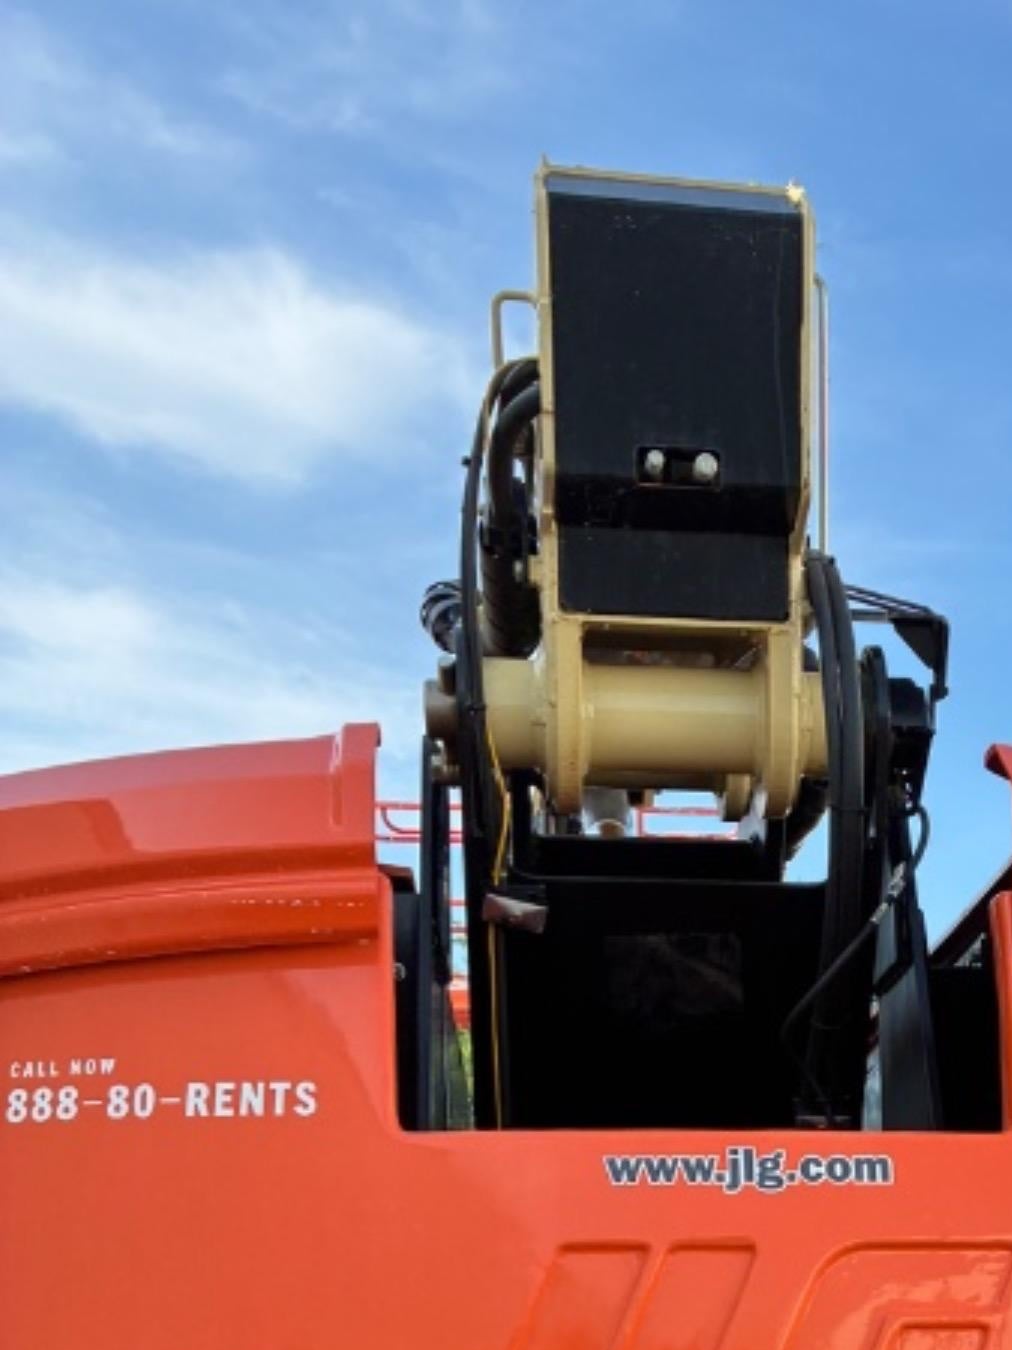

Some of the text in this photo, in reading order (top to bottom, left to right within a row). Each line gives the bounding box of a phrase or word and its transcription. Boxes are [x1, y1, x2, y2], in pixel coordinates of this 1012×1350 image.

[10, 1058, 117, 1078] CALL NOW
[5, 1081, 318, 1123] 888-80-RENTS
[602, 1146, 895, 1194] www.jlg.com
